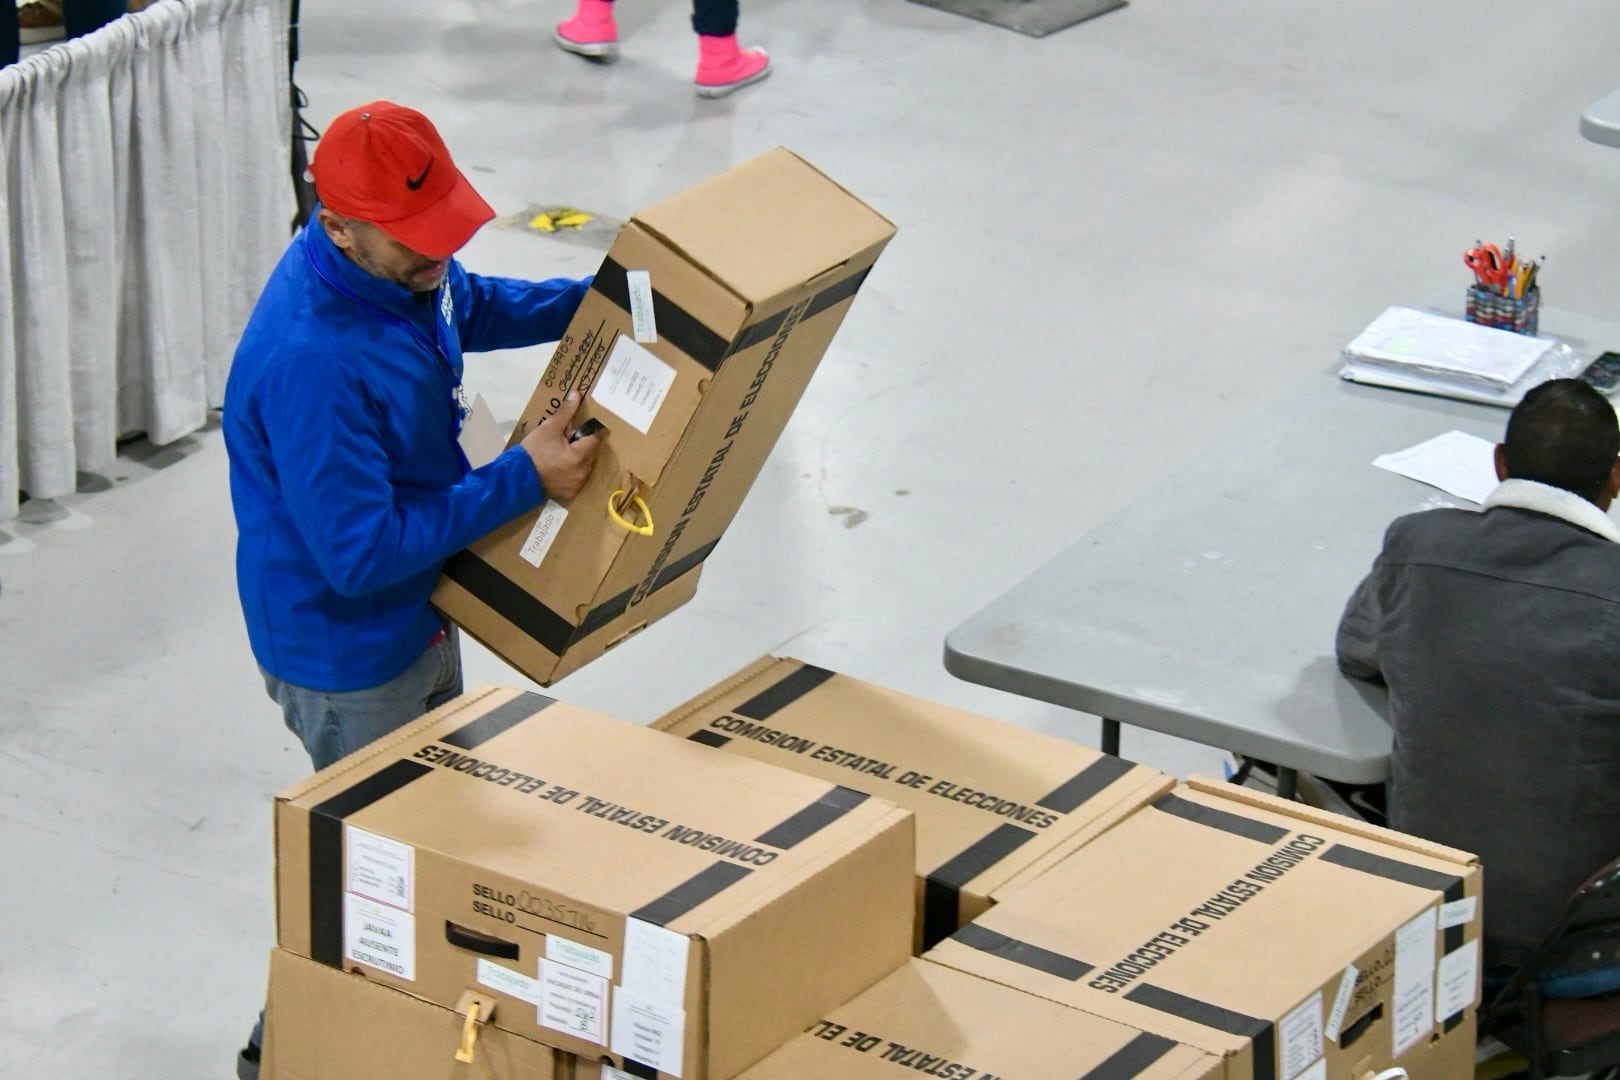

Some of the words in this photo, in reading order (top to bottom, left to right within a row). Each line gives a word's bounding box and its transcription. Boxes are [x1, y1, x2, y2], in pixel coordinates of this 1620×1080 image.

[630, 518, 690, 607] COMISION
[681, 440, 734, 517] ESTATAL
[724, 411, 749, 439] DE
[739, 297, 811, 410] ELECCIONES
[527, 513, 554, 553] Trabajado
[413, 745, 546, 795] ELECCIONES
[710, 714, 814, 754] COMISION
[810, 745, 899, 780] ESTATAL
[895, 771, 932, 789] DE
[927, 780, 1059, 830] ELECCIONES
[540, 785, 580, 805] DE
[576, 795, 668, 834] ESTATAL
[667, 824, 778, 866] COMISION
[1245, 834, 1326, 884] COMISION
[472, 884, 516, 907] SELLO
[472, 901, 516, 924] SELLO
[1190, 879, 1265, 920] ESTATAL
[1170, 916, 1211, 936] DE
[1088, 931, 1190, 994] ELECCIONES
[840, 1031, 883, 1053] DE
[880, 1042, 977, 1080] ESTATAL
